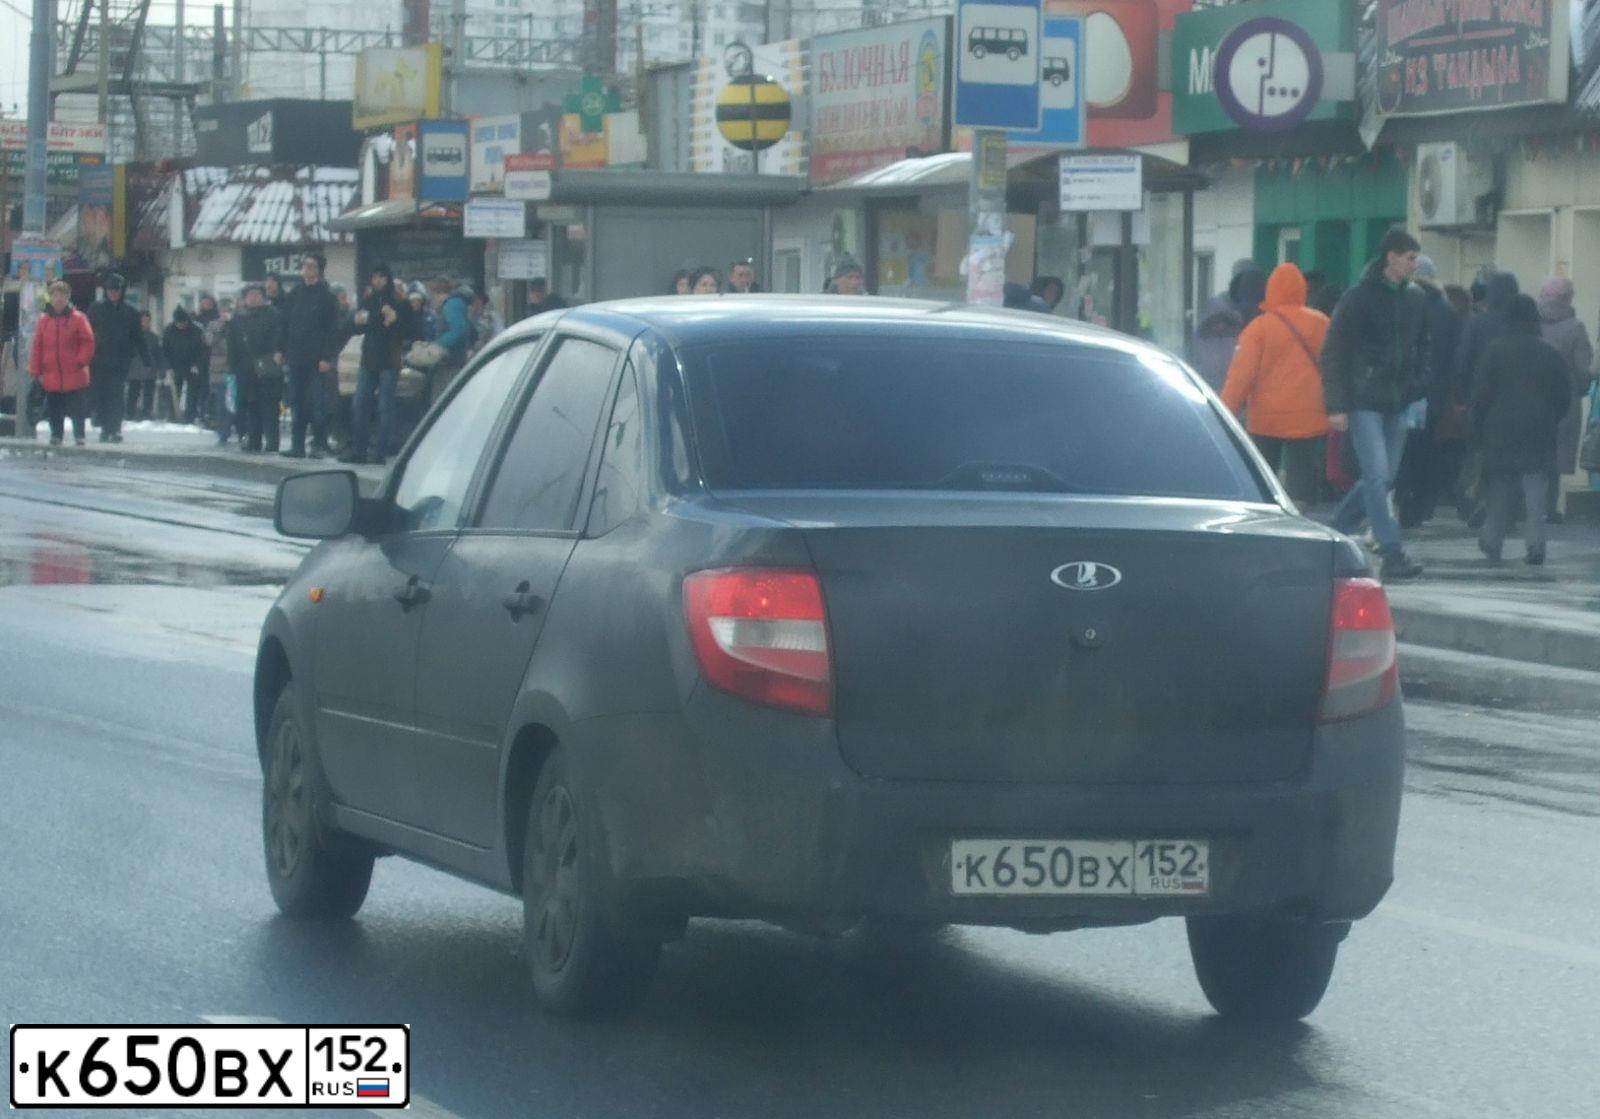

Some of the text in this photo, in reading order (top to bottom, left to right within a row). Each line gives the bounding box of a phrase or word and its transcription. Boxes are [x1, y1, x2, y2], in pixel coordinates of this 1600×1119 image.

[964, 844, 1199, 888] К650ВХ 152
[1150, 877, 1181, 890] RUS
